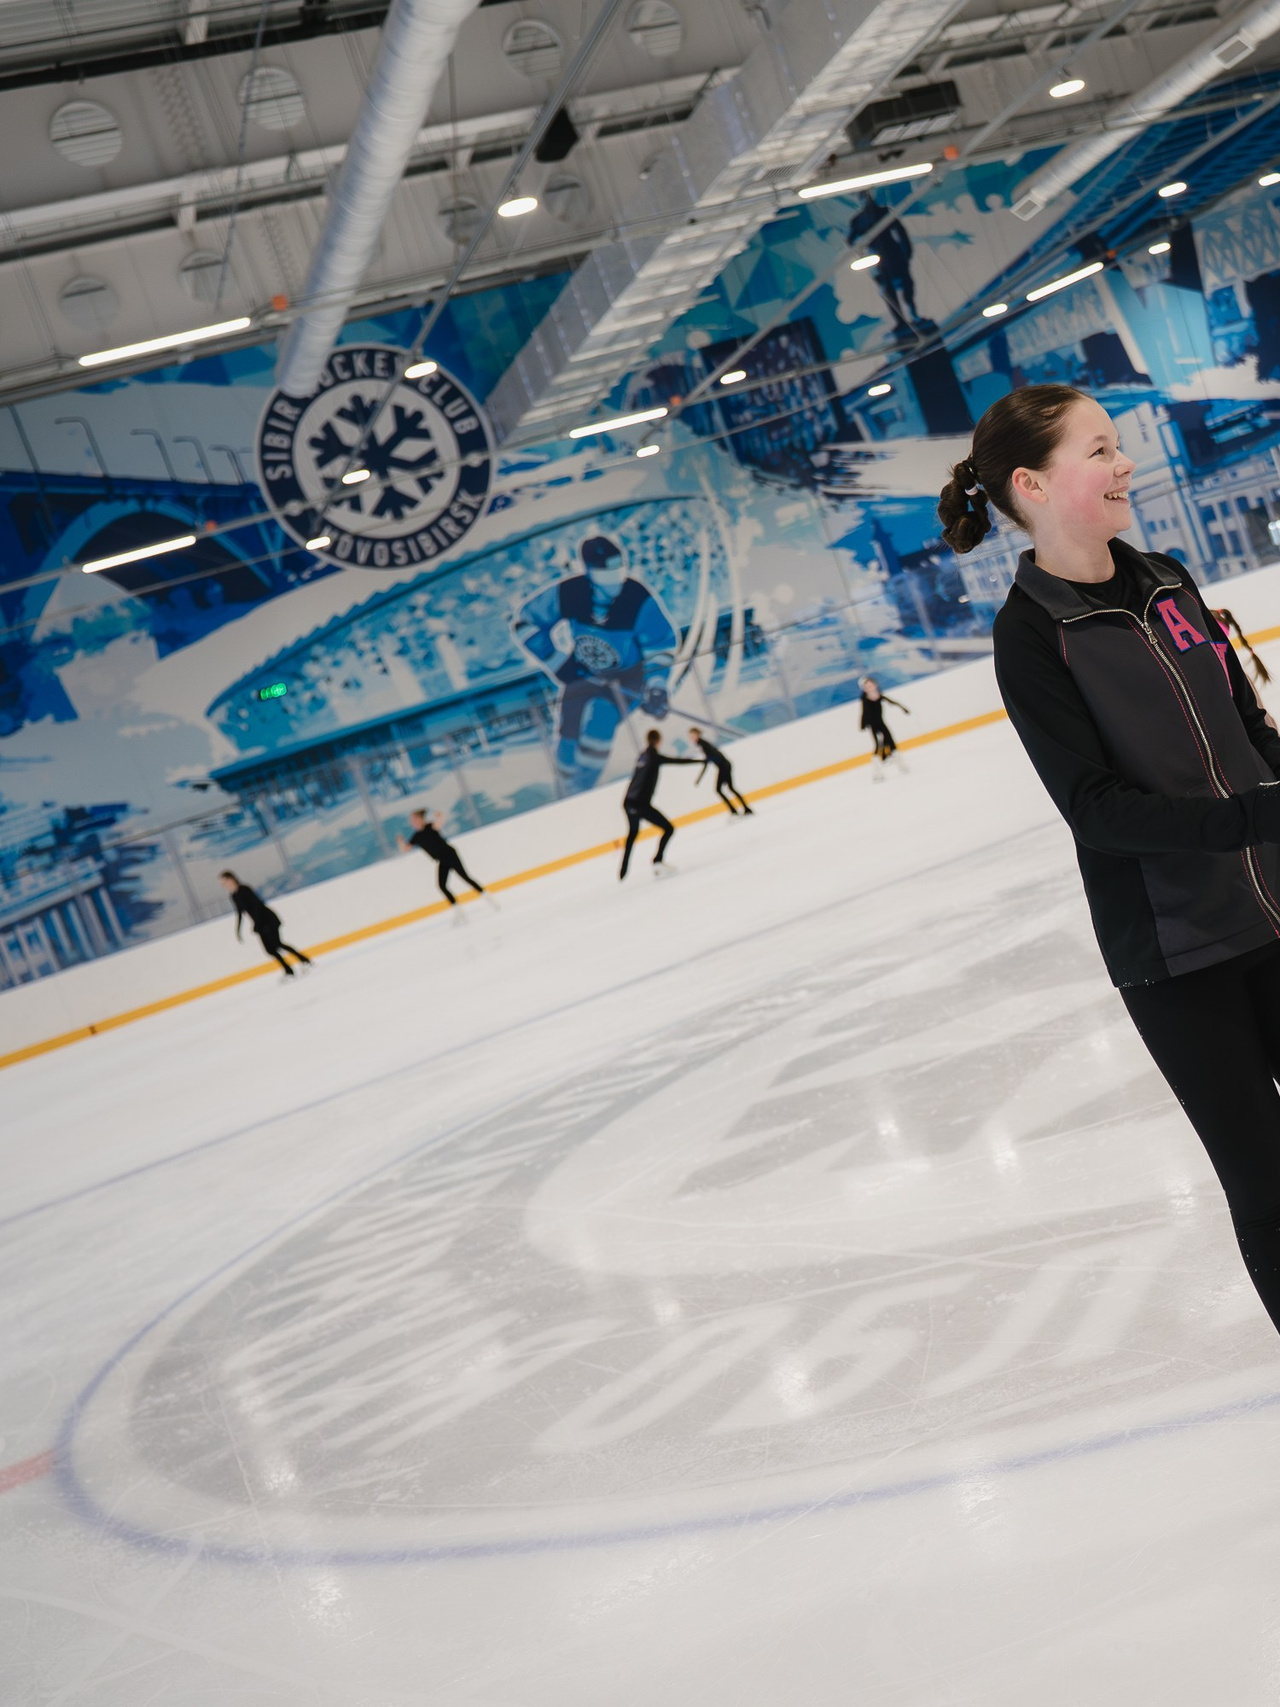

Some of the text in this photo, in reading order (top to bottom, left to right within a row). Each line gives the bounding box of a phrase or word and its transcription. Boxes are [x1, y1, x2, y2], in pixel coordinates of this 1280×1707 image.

[262, 350, 480, 481] SIBIR OCKE CLUB
